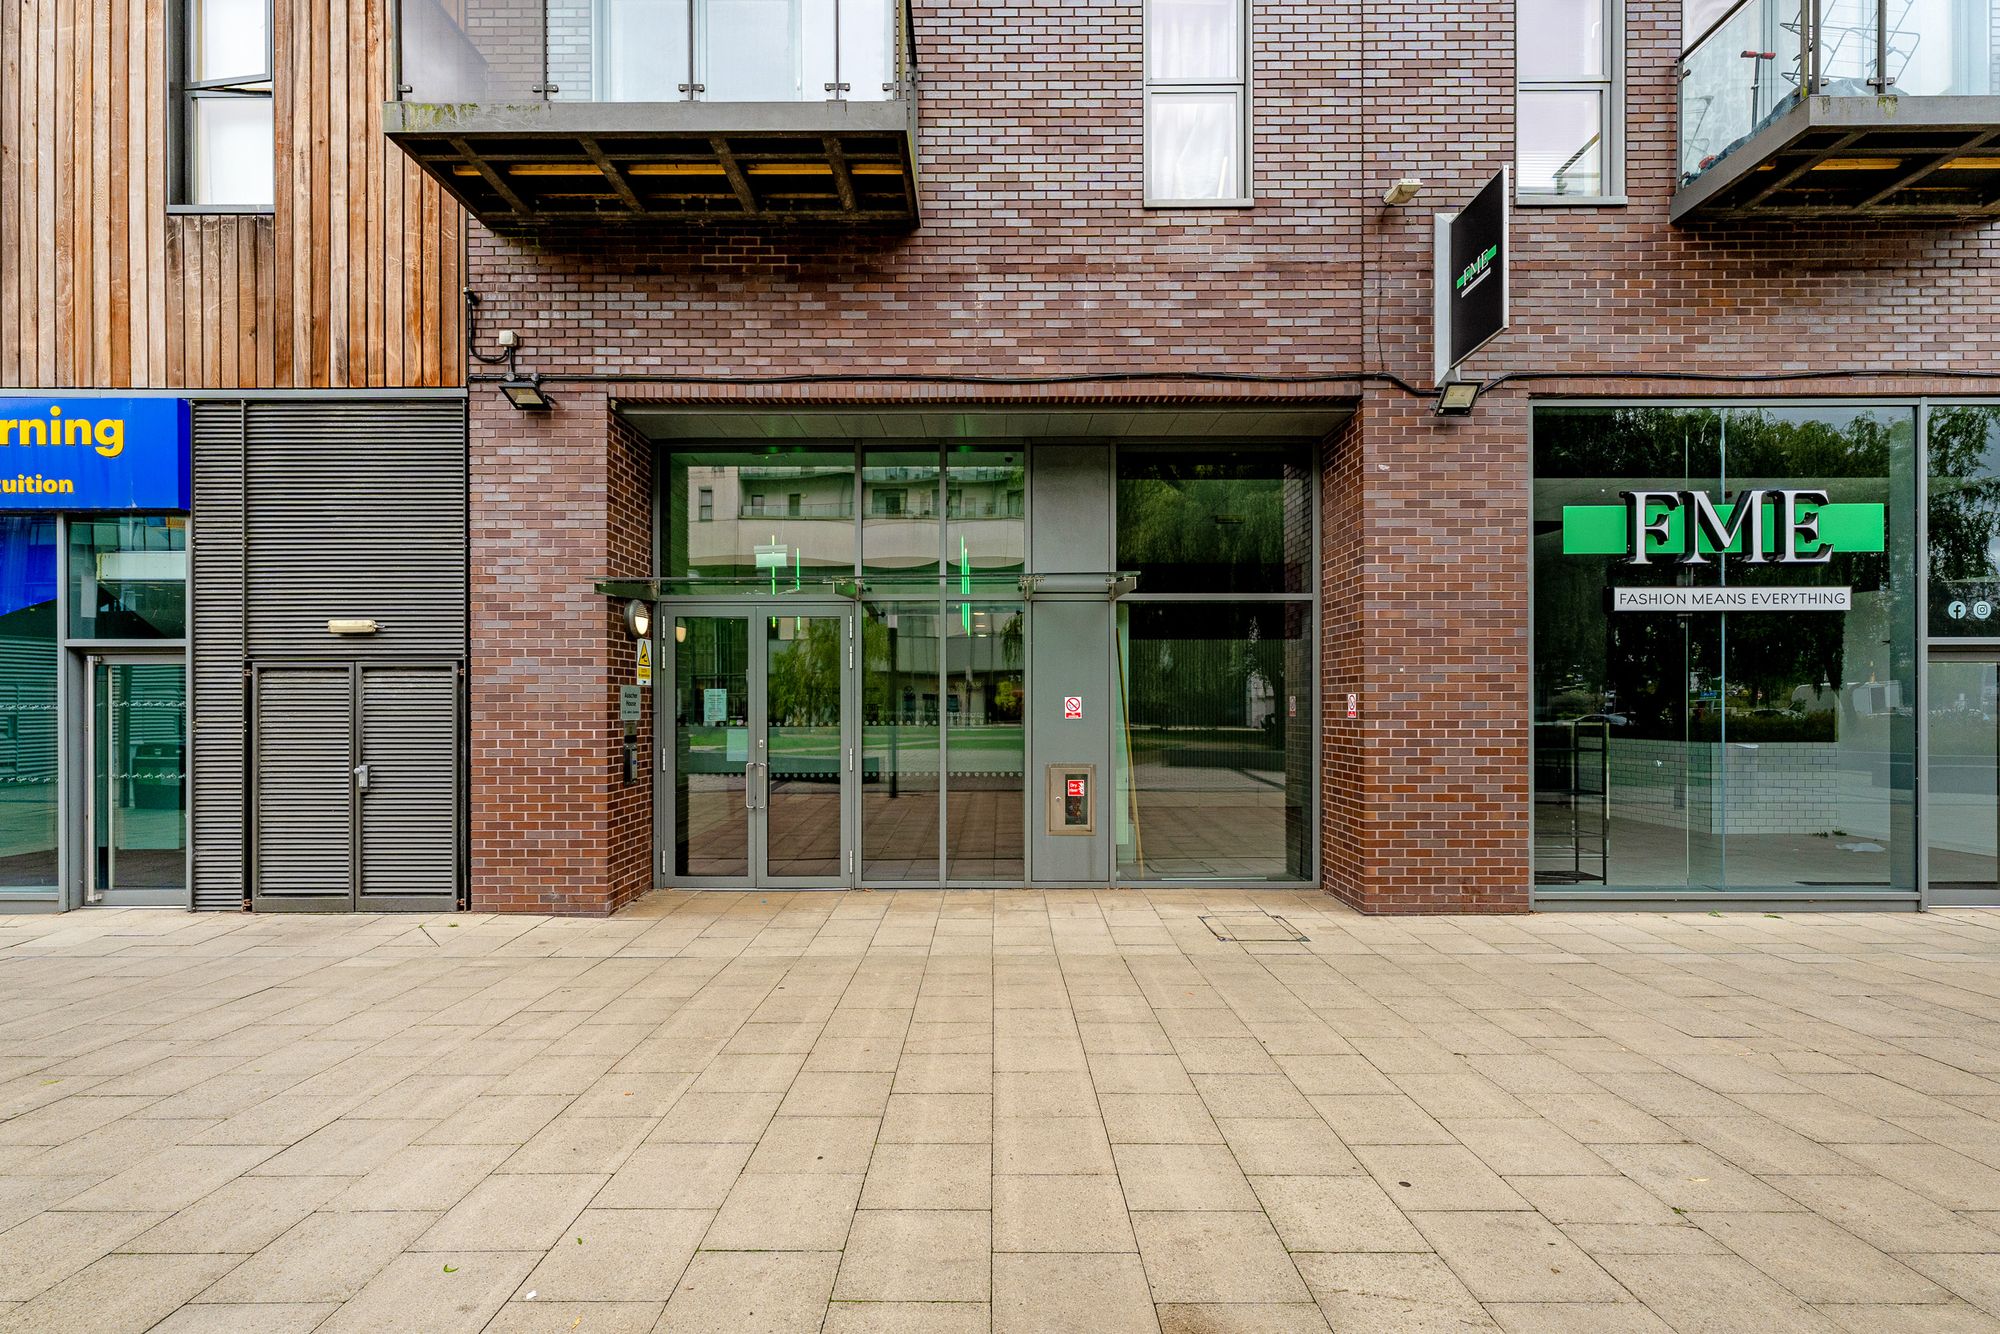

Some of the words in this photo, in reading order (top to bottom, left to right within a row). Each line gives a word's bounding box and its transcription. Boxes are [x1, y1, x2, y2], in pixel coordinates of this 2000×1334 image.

[1463, 249, 1488, 286] FME
[0, 406, 124, 458] rning
[1622, 489, 1834, 565] FME
[1619, 593, 1686, 605] FASHION
[1692, 593, 1746, 605] MEANS
[1751, 593, 1846, 605] EVERYTHING
